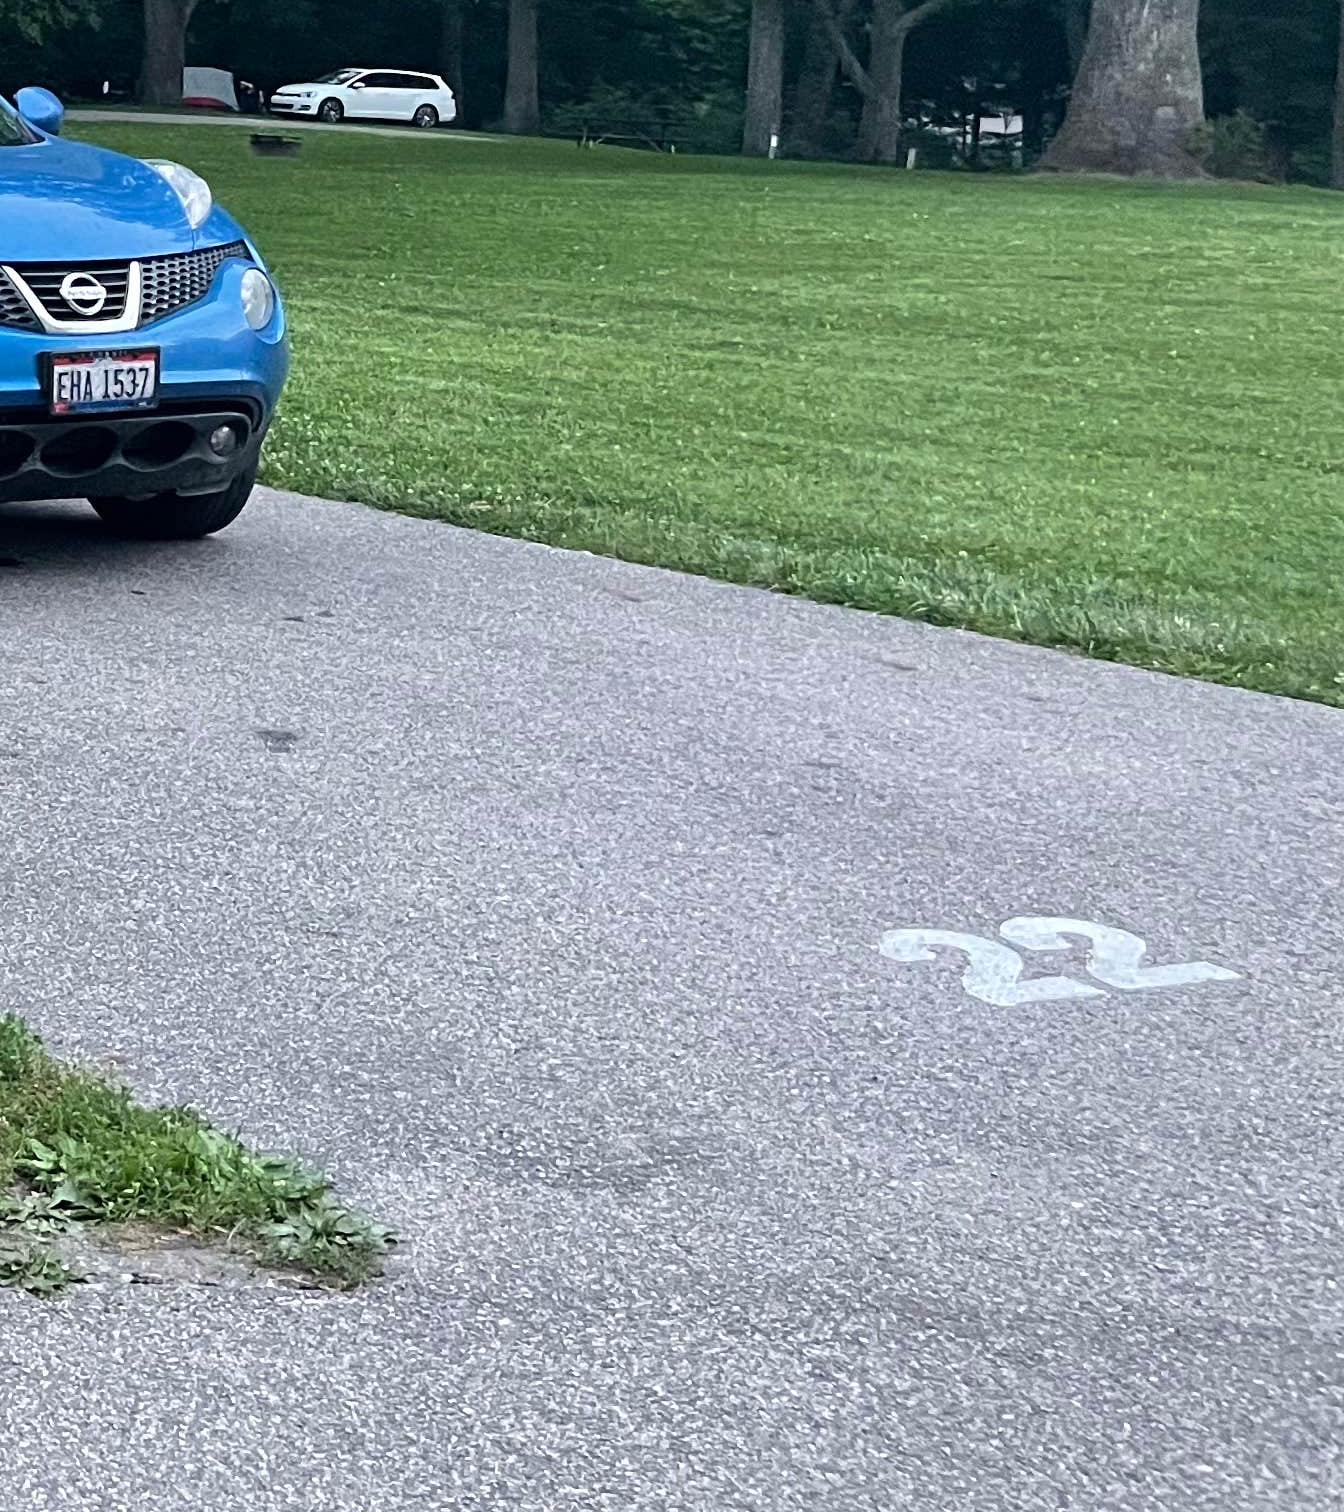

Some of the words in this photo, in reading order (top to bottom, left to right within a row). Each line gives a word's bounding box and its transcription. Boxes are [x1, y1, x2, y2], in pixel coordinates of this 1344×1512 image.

[58, 370, 93, 401] EHA
[102, 368, 149, 399] 1537
[878, 916, 1241, 1006] 22
